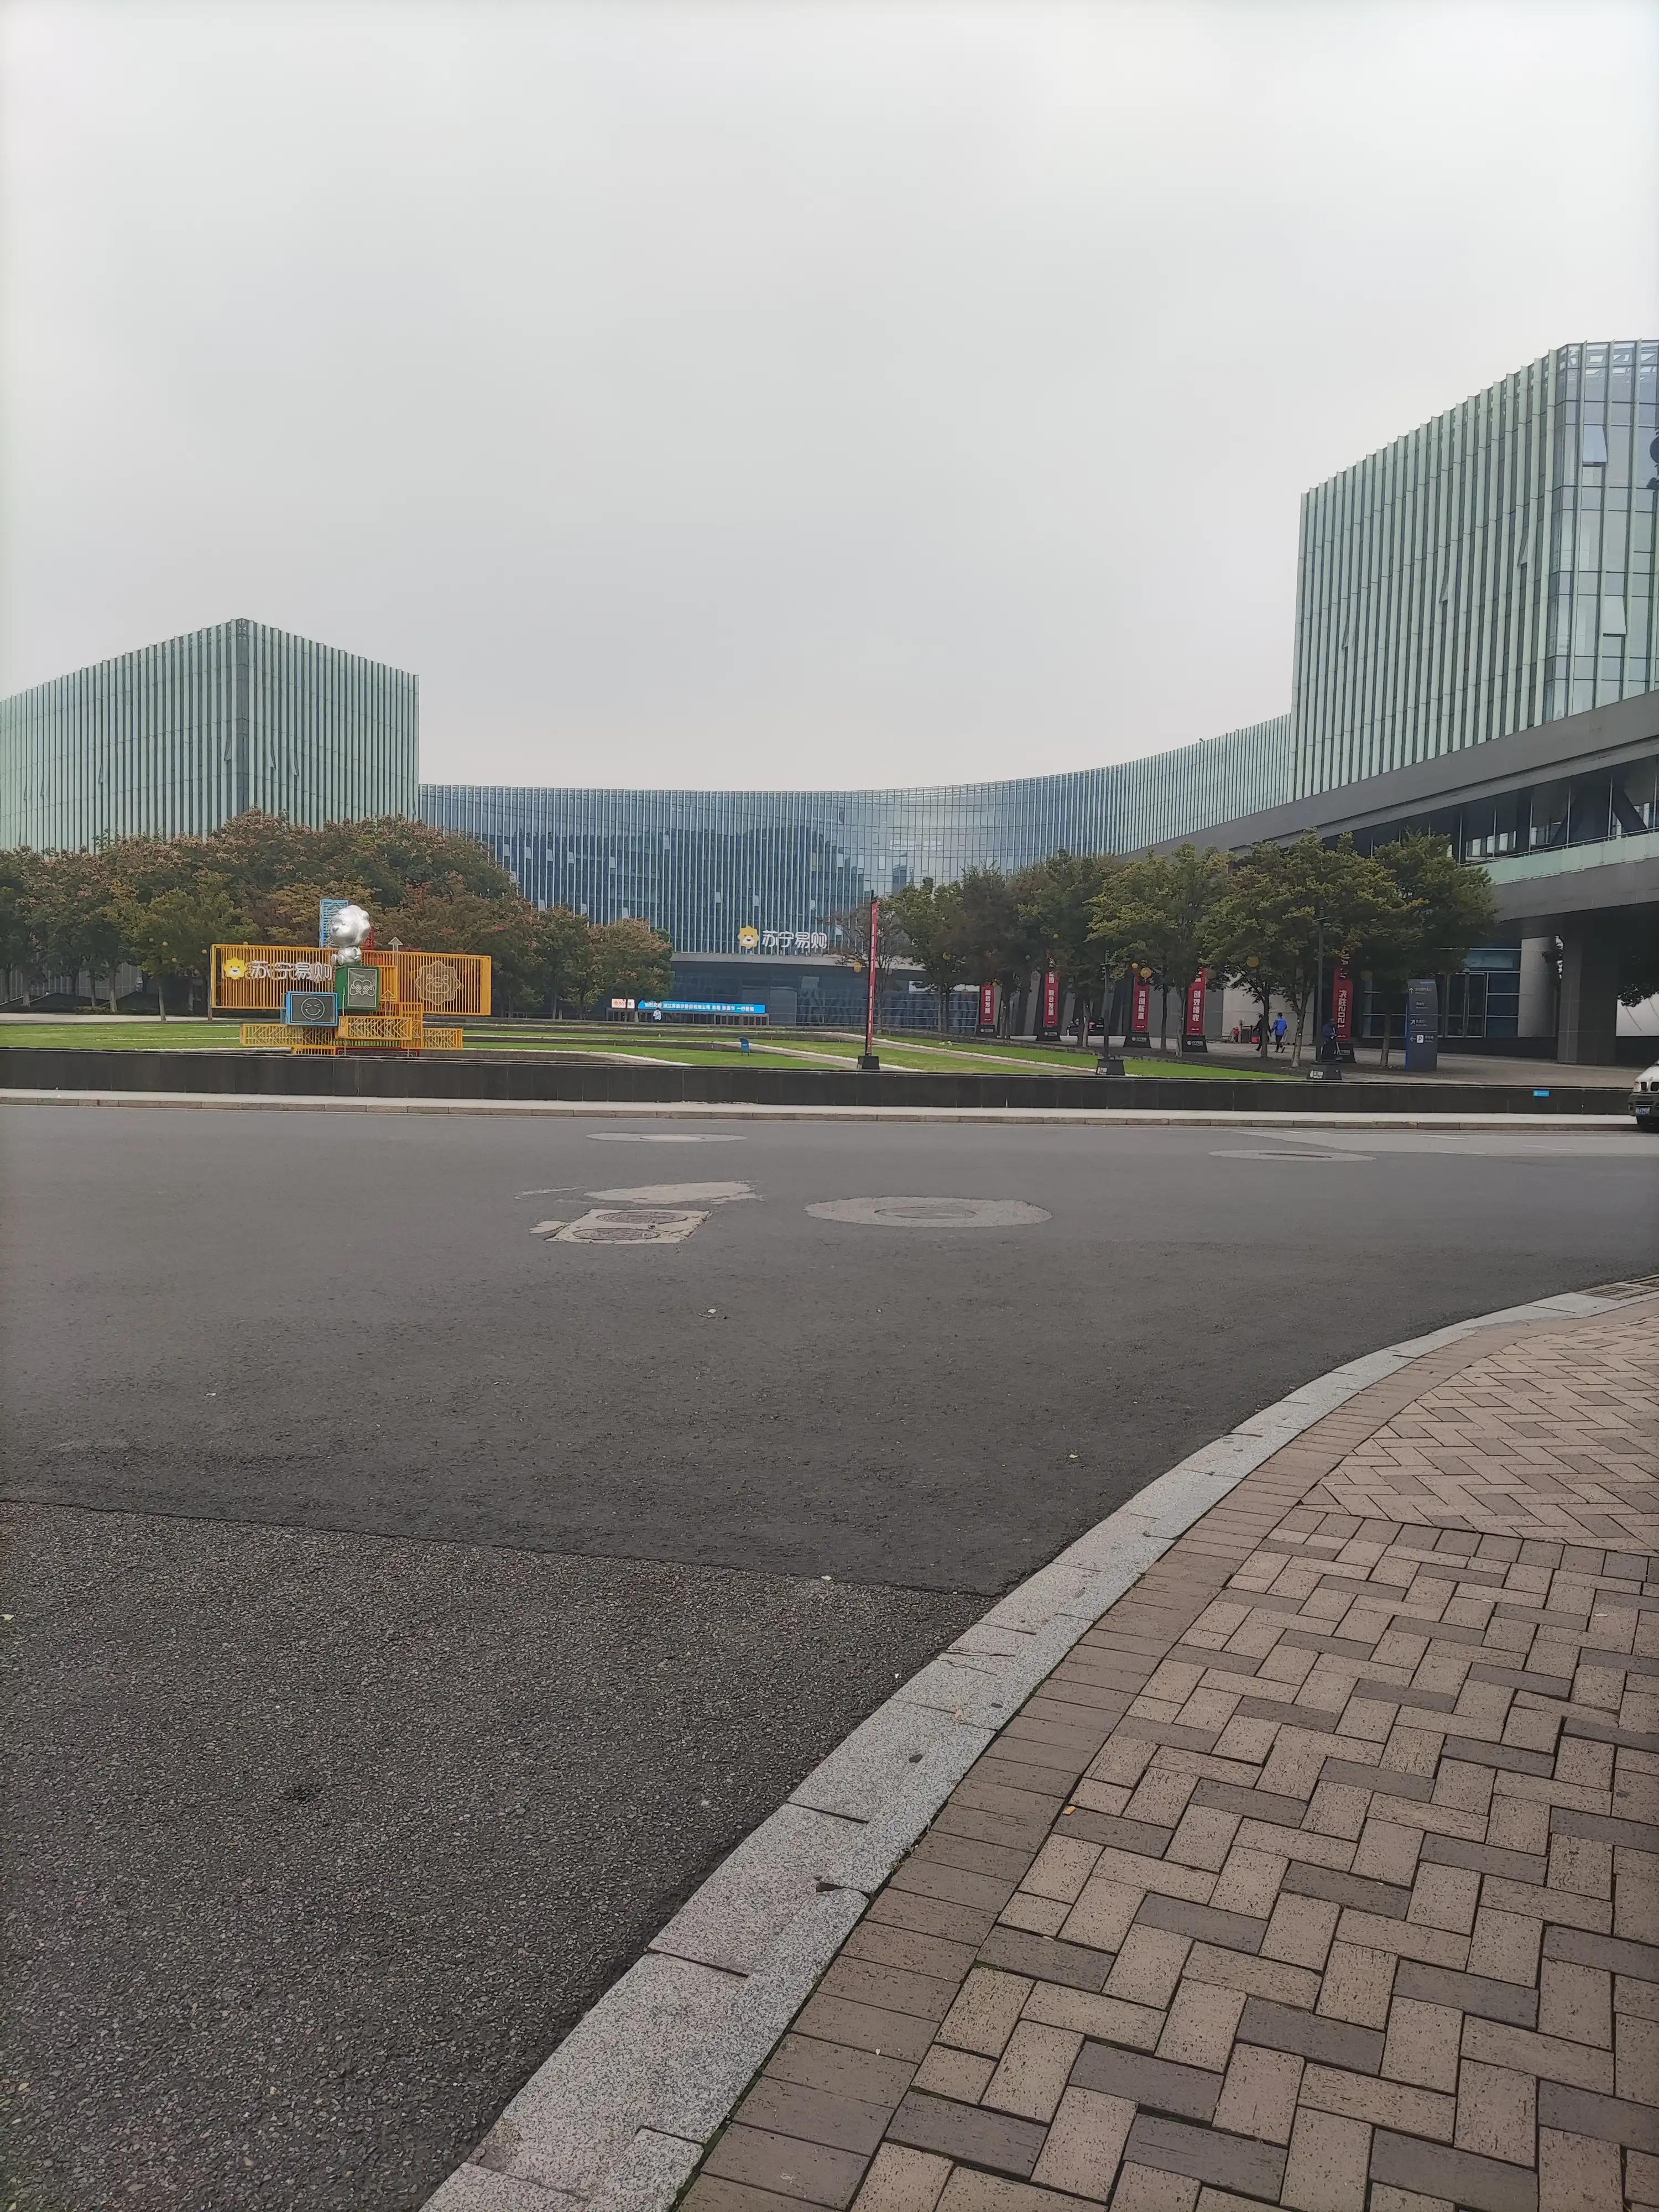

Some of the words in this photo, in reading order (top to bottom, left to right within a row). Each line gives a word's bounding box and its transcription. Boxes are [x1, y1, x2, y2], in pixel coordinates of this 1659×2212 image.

[761, 930, 827, 949] 苏宁易购
[249, 959, 332, 982] 苏宁易购
